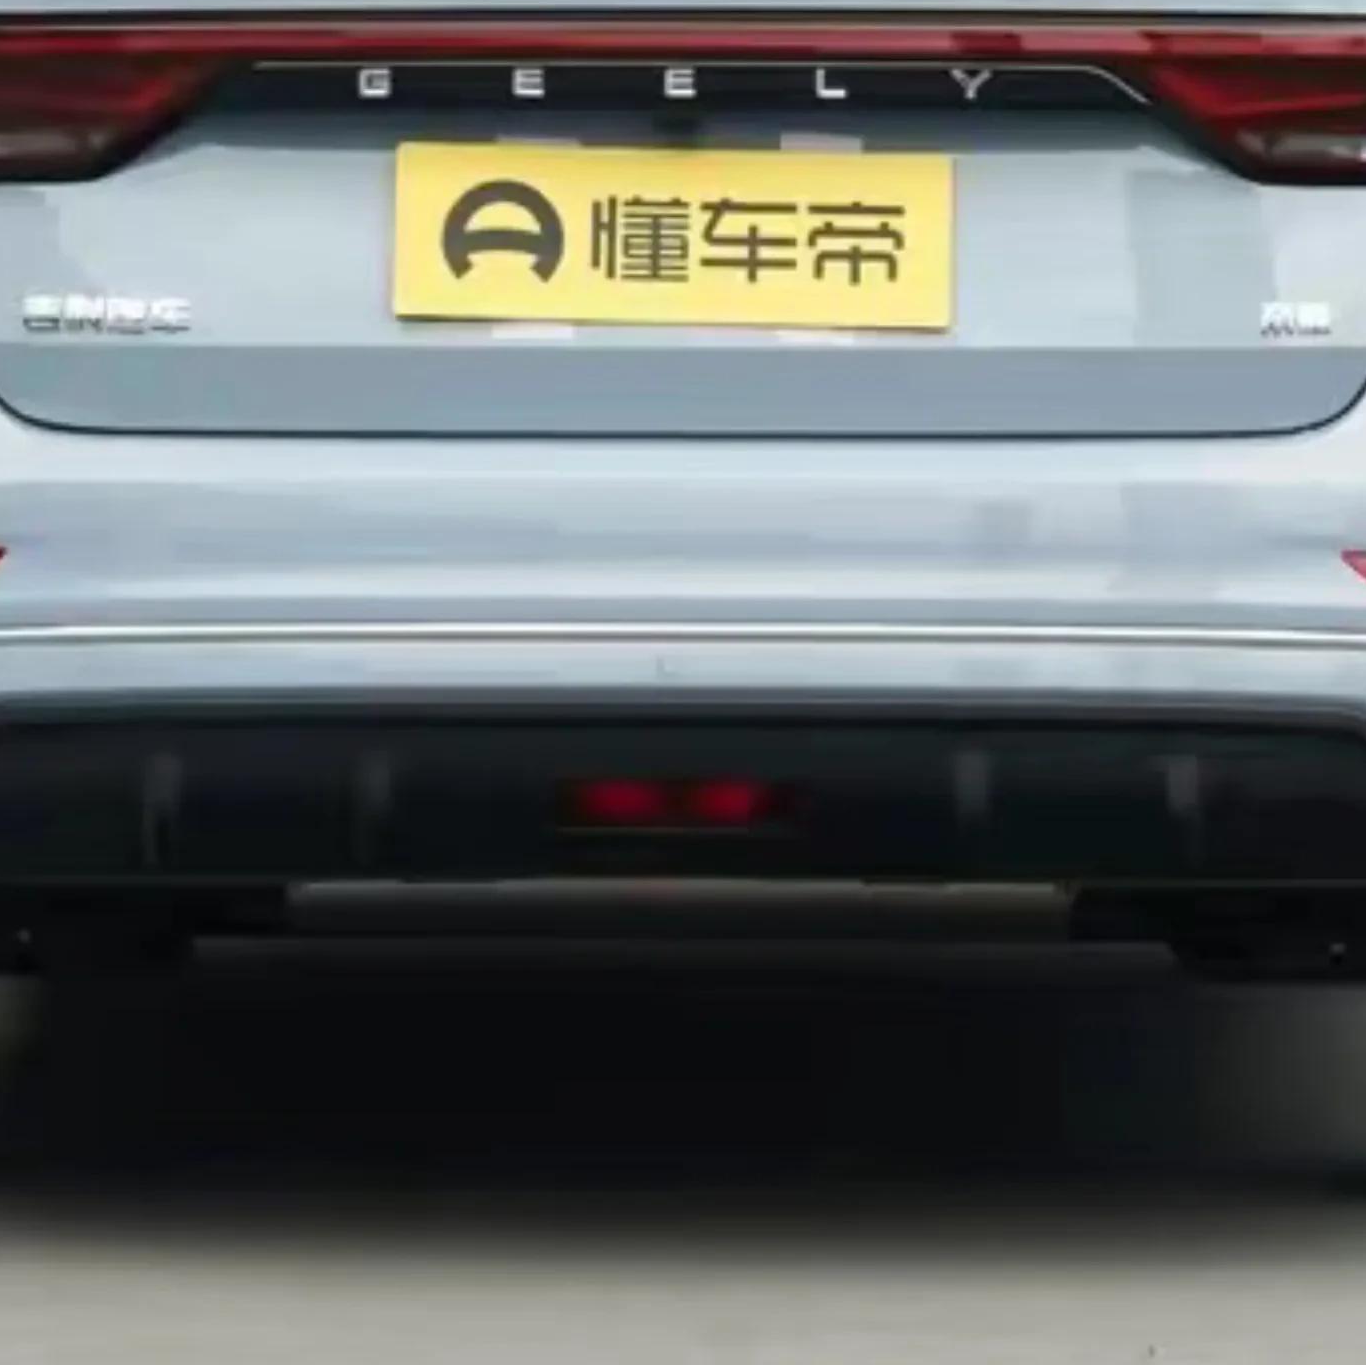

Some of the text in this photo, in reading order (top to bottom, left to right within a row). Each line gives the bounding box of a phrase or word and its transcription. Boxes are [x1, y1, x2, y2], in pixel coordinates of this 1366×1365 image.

[358, 68, 992, 99] GEELY
[591, 194, 905, 286] 懂车帝
